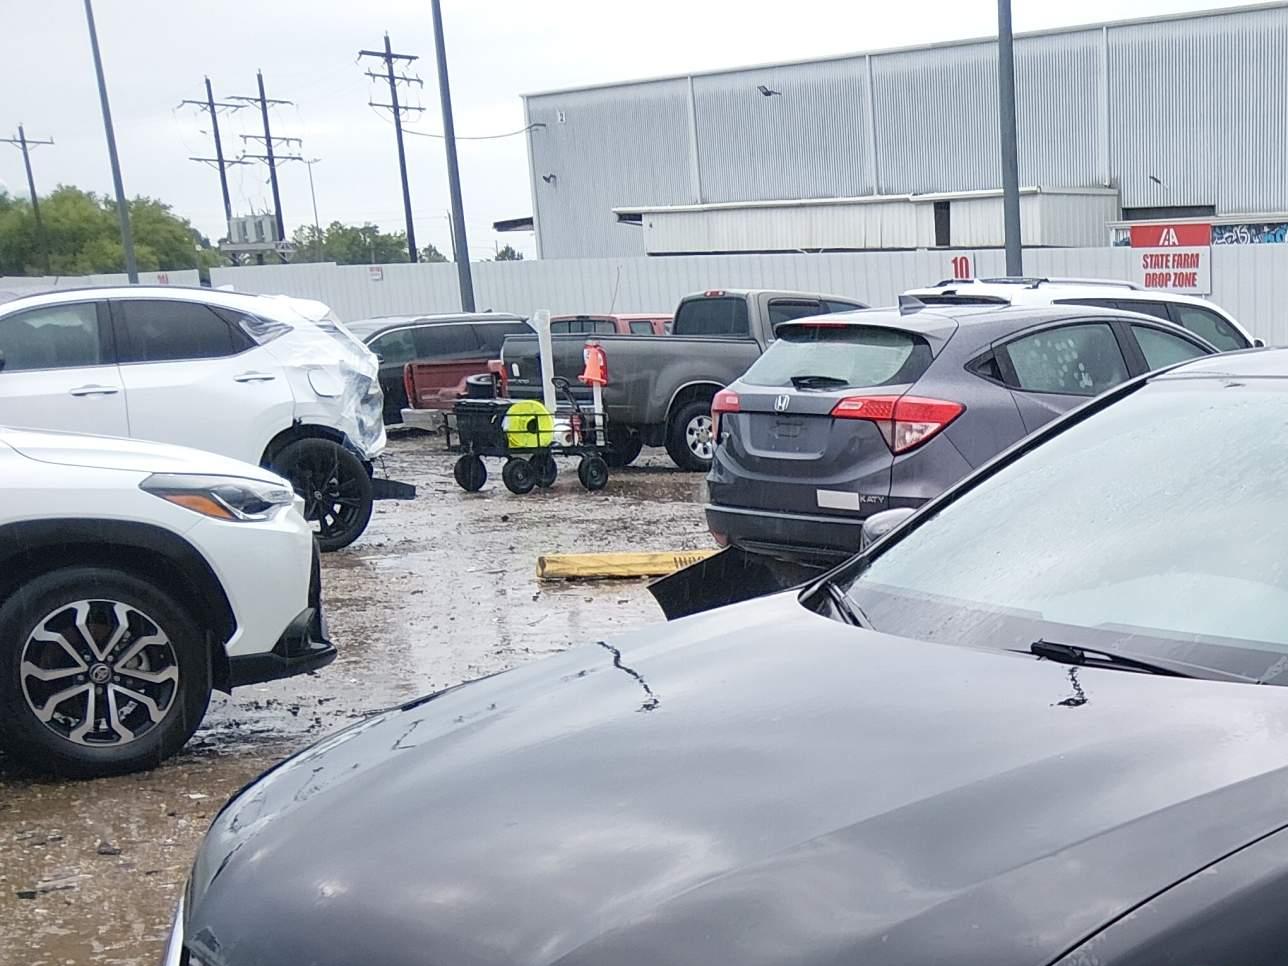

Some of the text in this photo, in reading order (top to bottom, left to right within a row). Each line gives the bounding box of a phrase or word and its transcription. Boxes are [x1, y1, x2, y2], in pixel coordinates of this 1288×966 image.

[951, 256, 970, 279] 10
[1142, 252, 1200, 269] STATE FARM
[1145, 271, 1198, 288] DROP ZONE
[860, 495, 884, 504] KATY
